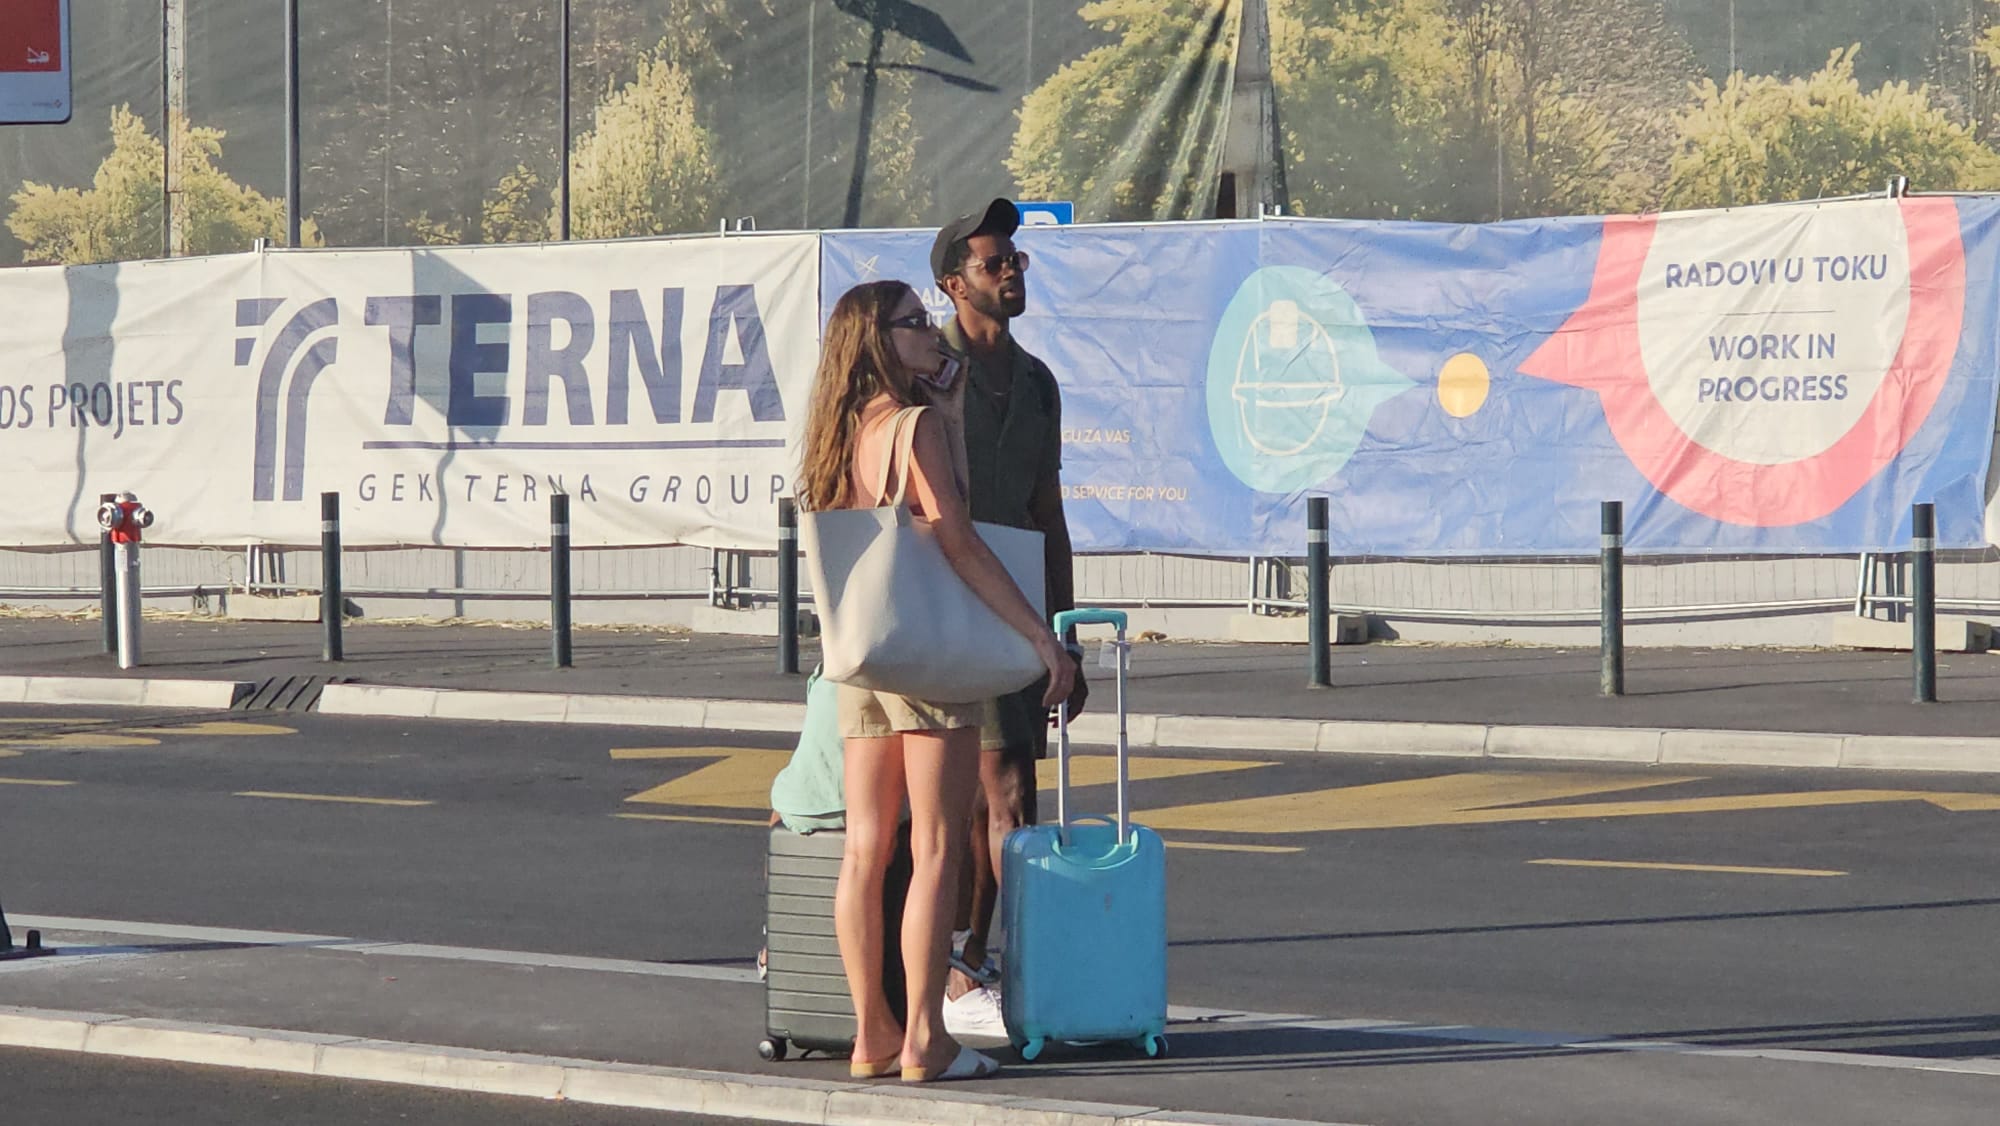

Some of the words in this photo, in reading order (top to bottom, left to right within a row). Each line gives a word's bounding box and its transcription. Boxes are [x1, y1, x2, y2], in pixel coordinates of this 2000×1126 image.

[1665, 258, 1776, 288] RADOVI
[1784, 257, 1804, 282] U
[1813, 254, 1887, 283] TOKU
[364, 283, 786, 426] TERNA
[1709, 333, 1800, 361] WORK
[1807, 332, 1836, 360] IN
[1697, 373, 1849, 403] PROGRESS
[48, 379, 184, 440] PROJETS
[1084, 429, 1102, 444] ZA
[358, 473, 433, 502] GEK
[464, 473, 597, 502] TERNA
[629, 474, 785, 504] GROUP
[1072, 486, 1125, 501] SERVICE
[1127, 486, 1155, 501] FOR
